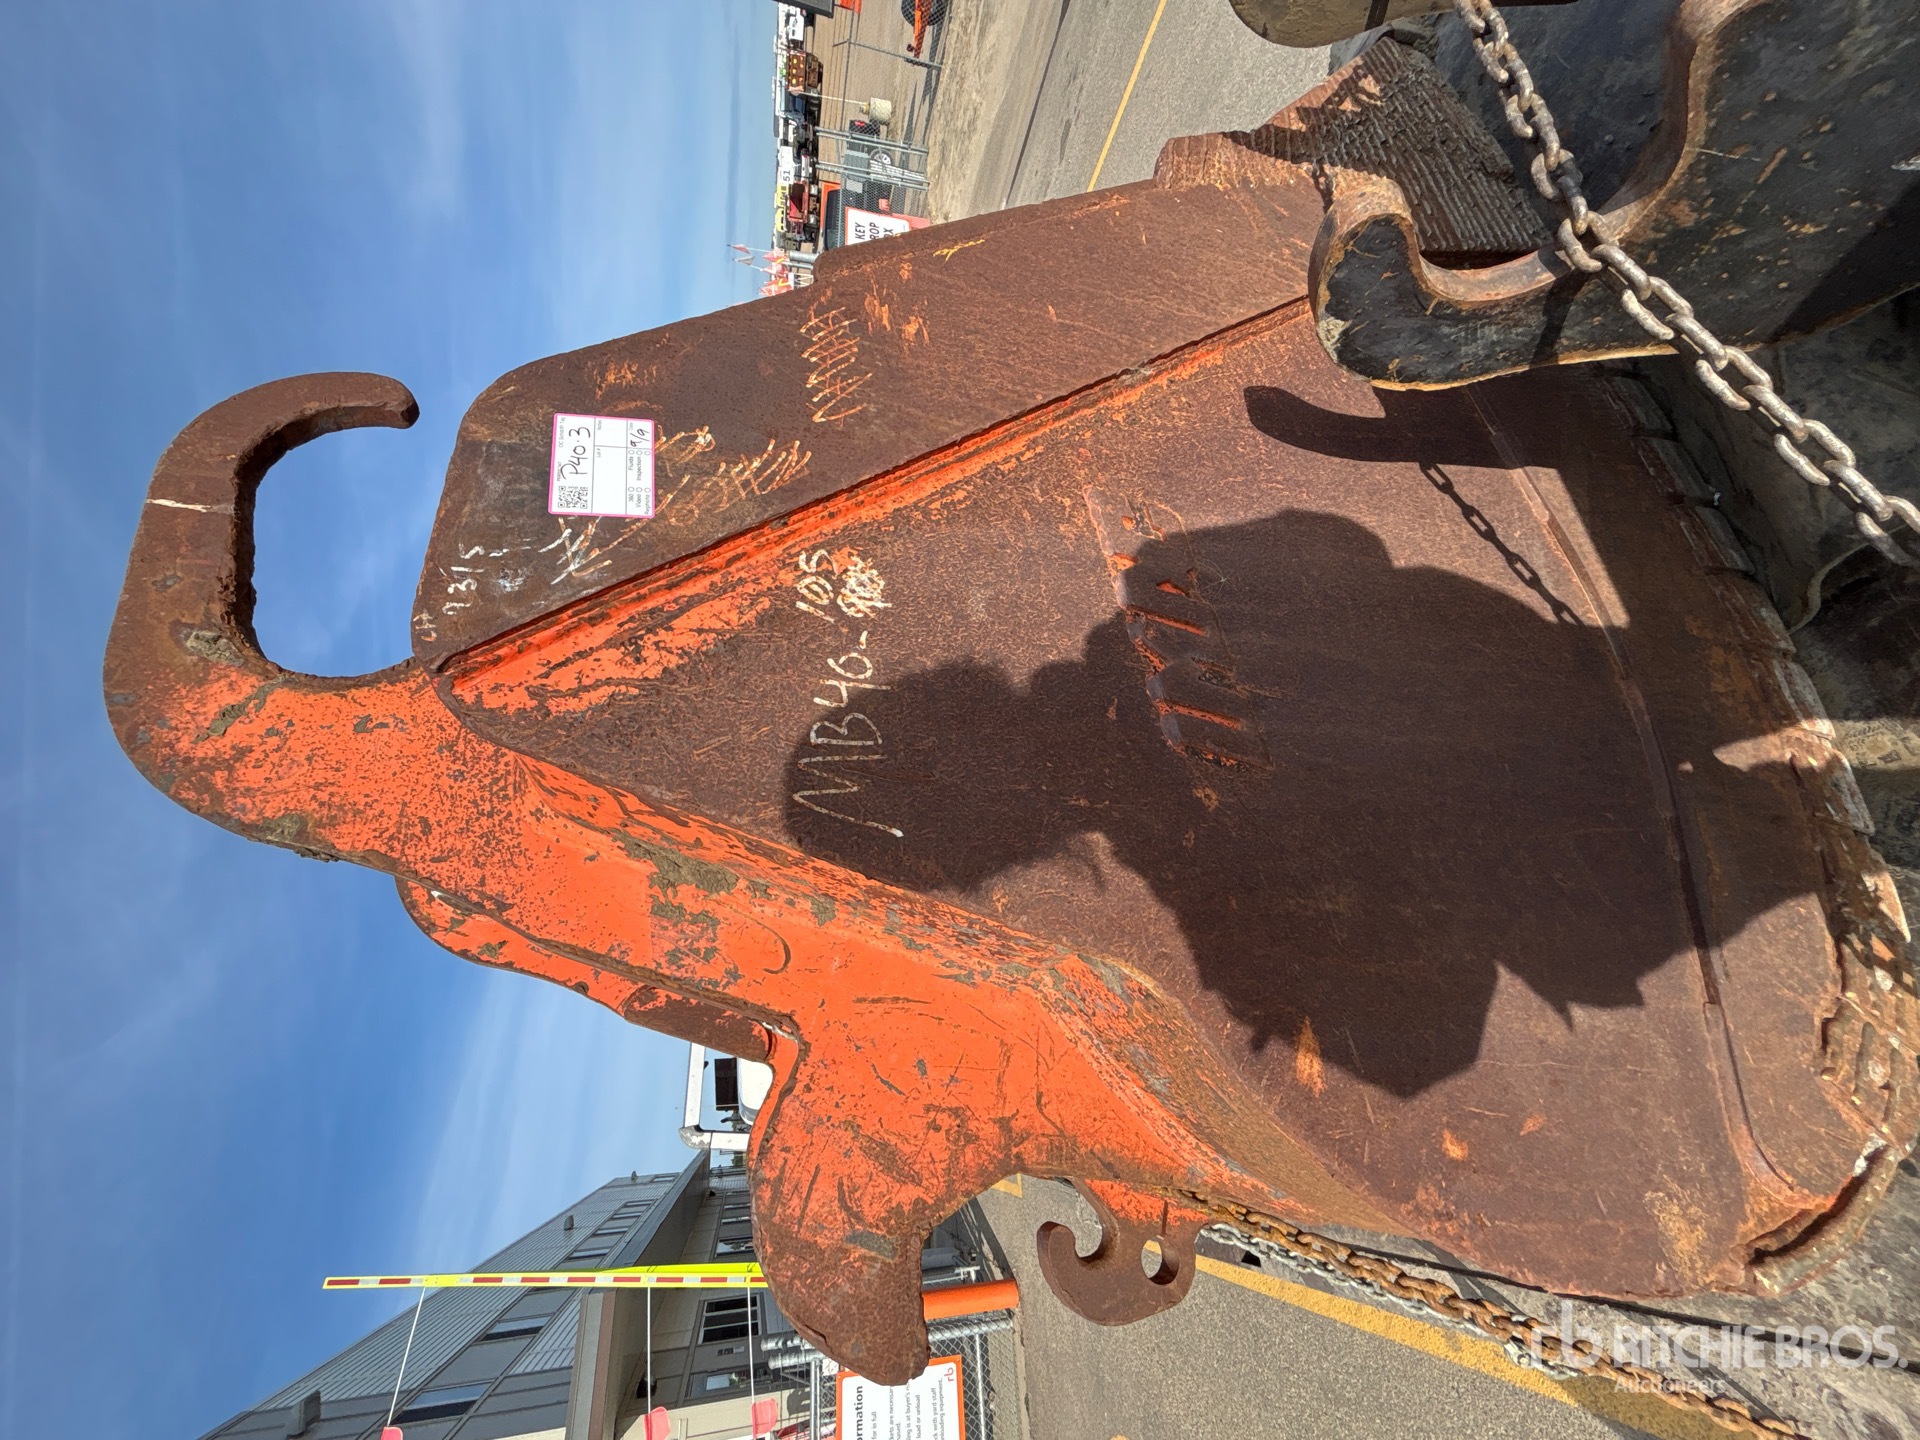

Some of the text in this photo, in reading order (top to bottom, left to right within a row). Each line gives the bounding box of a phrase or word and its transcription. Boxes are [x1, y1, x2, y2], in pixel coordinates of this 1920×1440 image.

[783, 170, 791, 182] 51
[854, 222, 865, 240] KEY
[869, 222, 880, 239] ROP
[944, 1367, 954, 1382] rb
